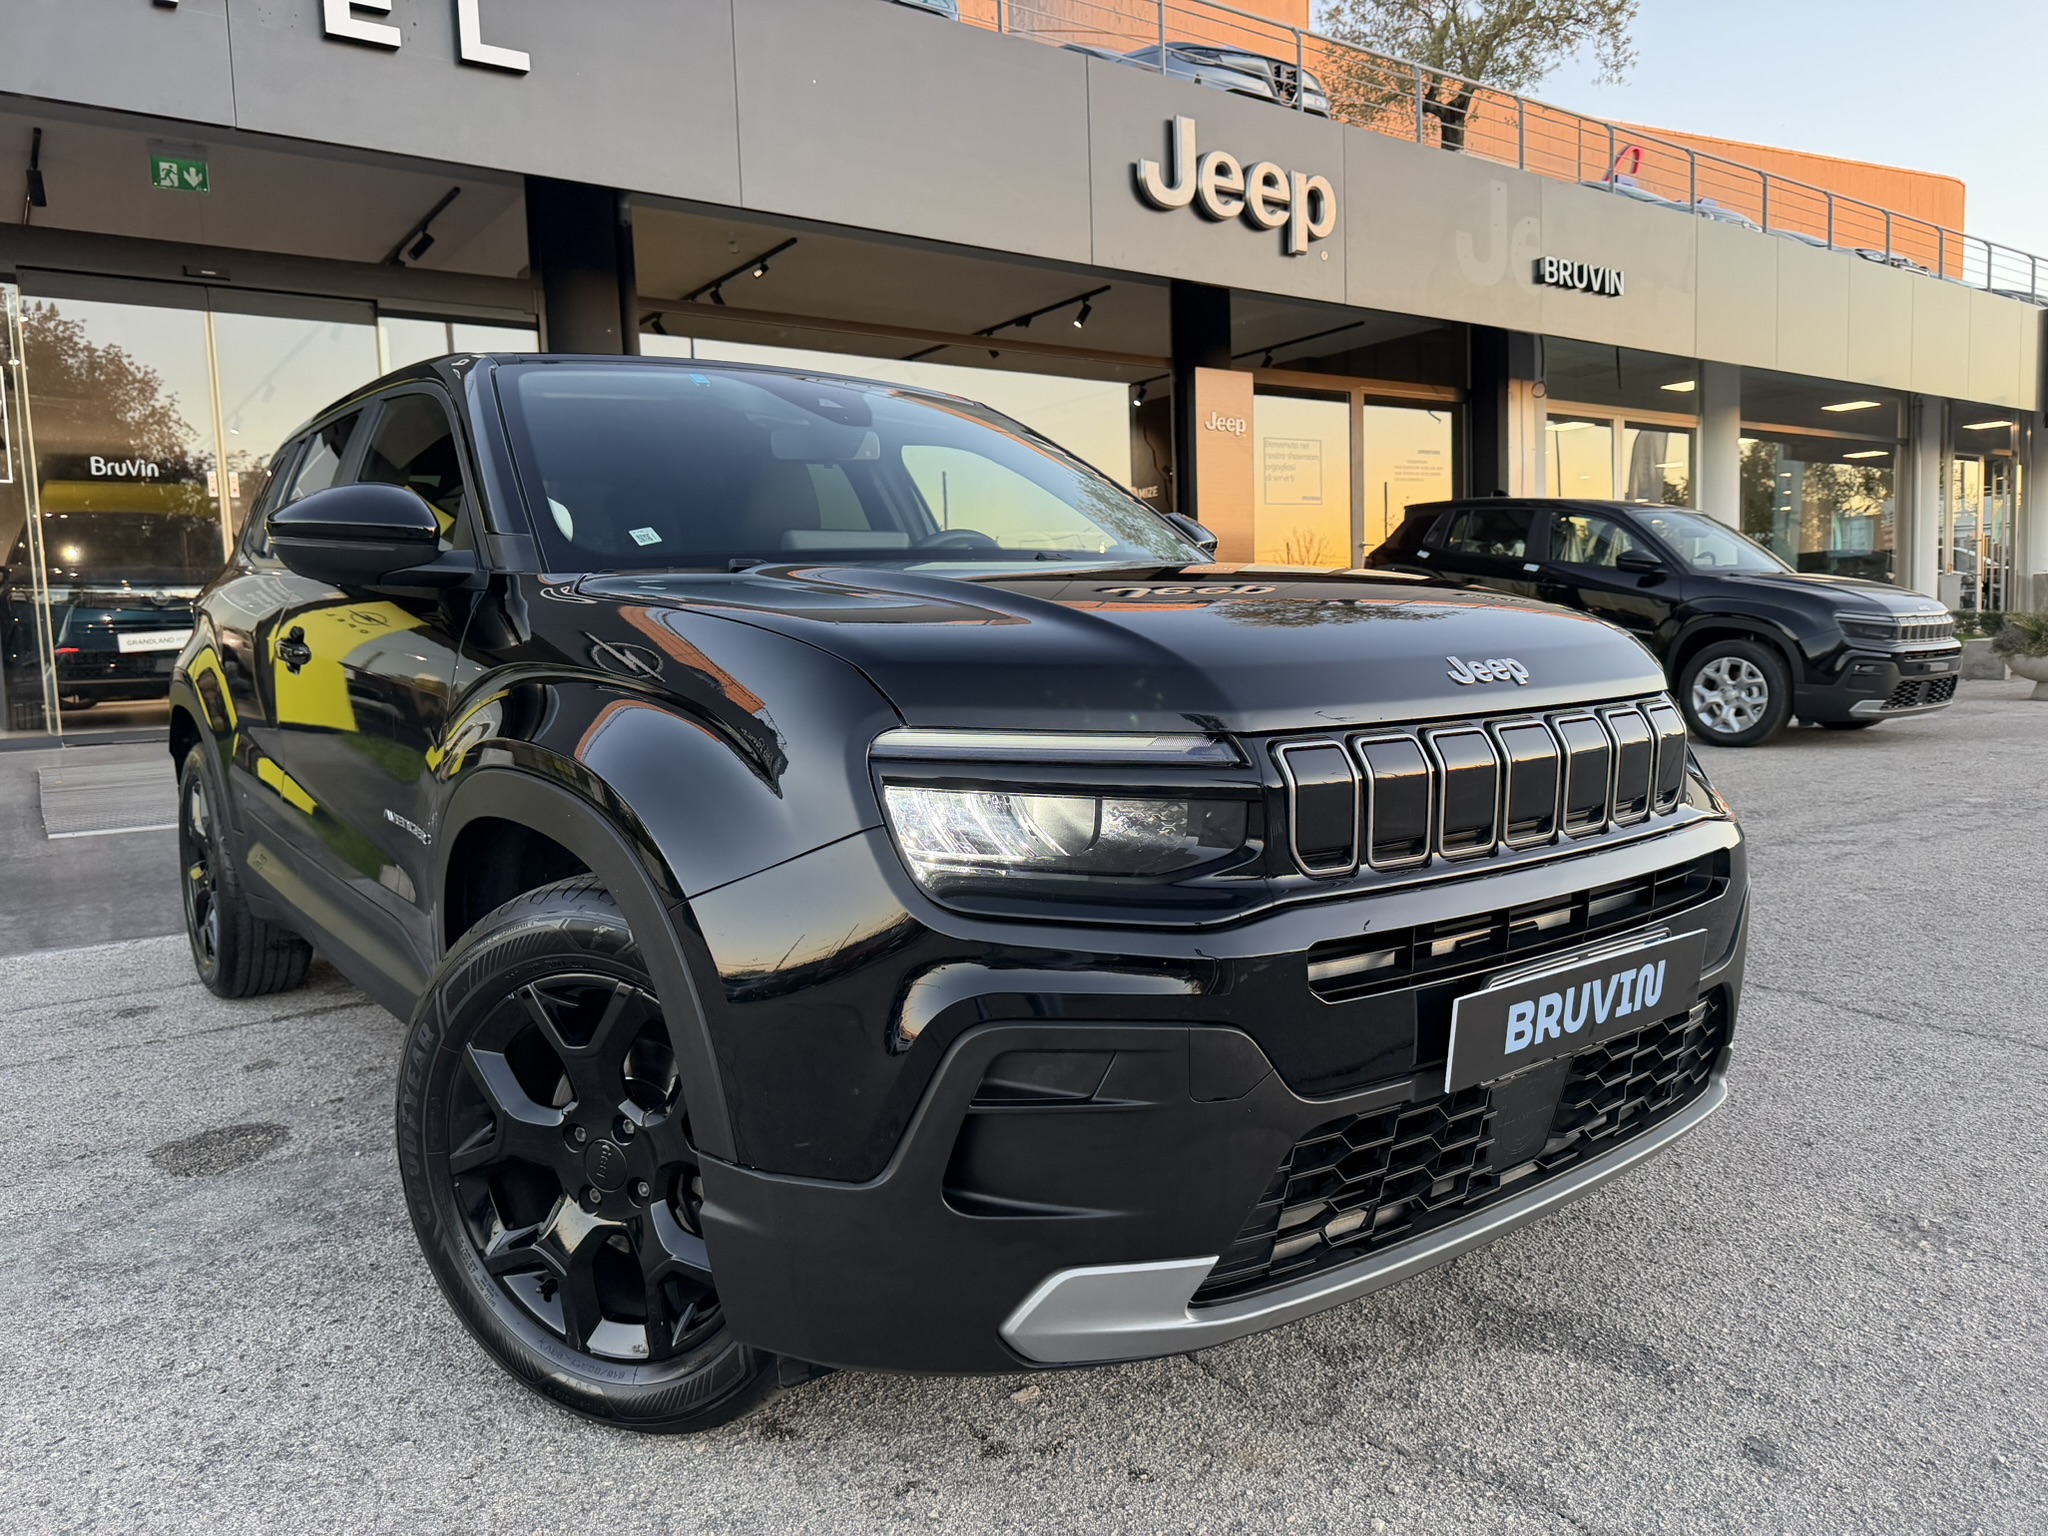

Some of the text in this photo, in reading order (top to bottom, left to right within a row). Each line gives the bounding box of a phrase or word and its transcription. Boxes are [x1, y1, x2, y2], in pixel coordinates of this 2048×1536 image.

[153, 0, 530, 72] EL
[1137, 115, 1337, 256] Jeep
[1541, 256, 1625, 296] BRUVIN
[1204, 411, 1247, 437] Jeep
[90, 455, 160, 478] BruVin
[1446, 655, 1529, 685] Jeep
[1504, 959, 1666, 1055] BRUVIN
[402, 1022, 435, 1225] GOODYEAR
